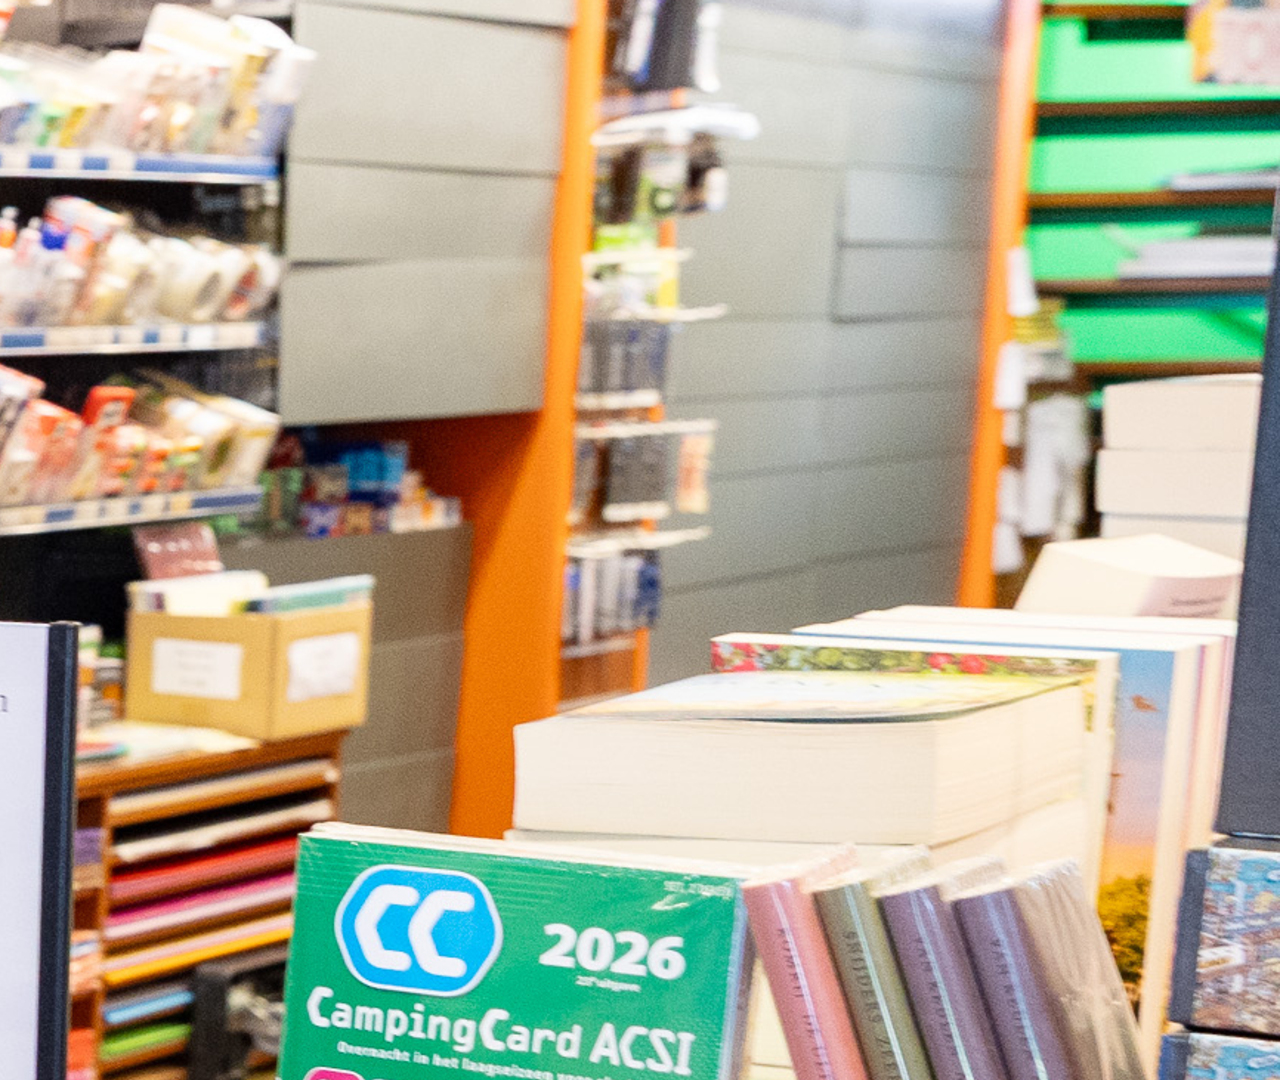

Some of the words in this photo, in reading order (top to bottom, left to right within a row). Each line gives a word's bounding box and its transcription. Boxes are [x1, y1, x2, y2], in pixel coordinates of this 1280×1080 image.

[354, 884, 475, 979] CC
[539, 923, 686, 980] 2026
[307, 986, 582, 1060] CampingCard
[589, 1022, 697, 1077] ACSI
[337, 1040, 411, 1065] Overnacht
[414, 1050, 429, 1062] in
[432, 1054, 458, 1070] het
